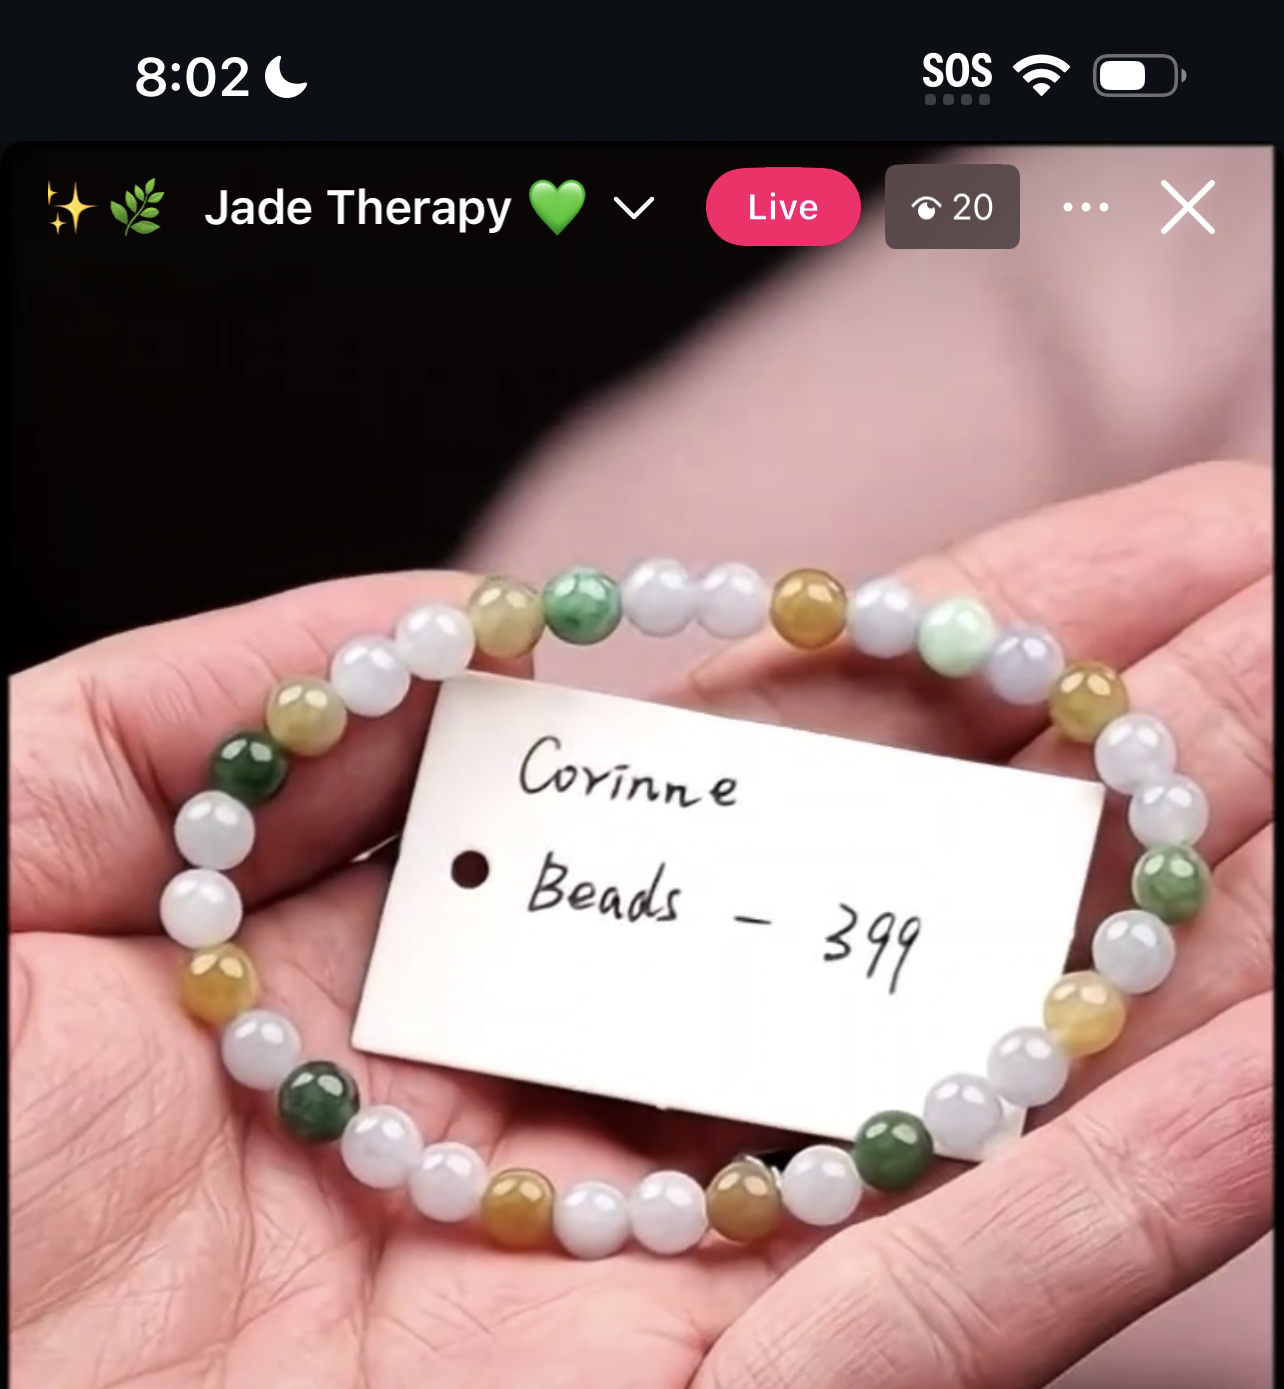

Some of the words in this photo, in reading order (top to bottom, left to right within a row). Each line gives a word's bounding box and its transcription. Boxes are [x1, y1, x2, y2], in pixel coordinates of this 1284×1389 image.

[518, 735, 738, 808] Corinne
[527, 850, 682, 924] Beads
[823, 902, 921, 995] 399
